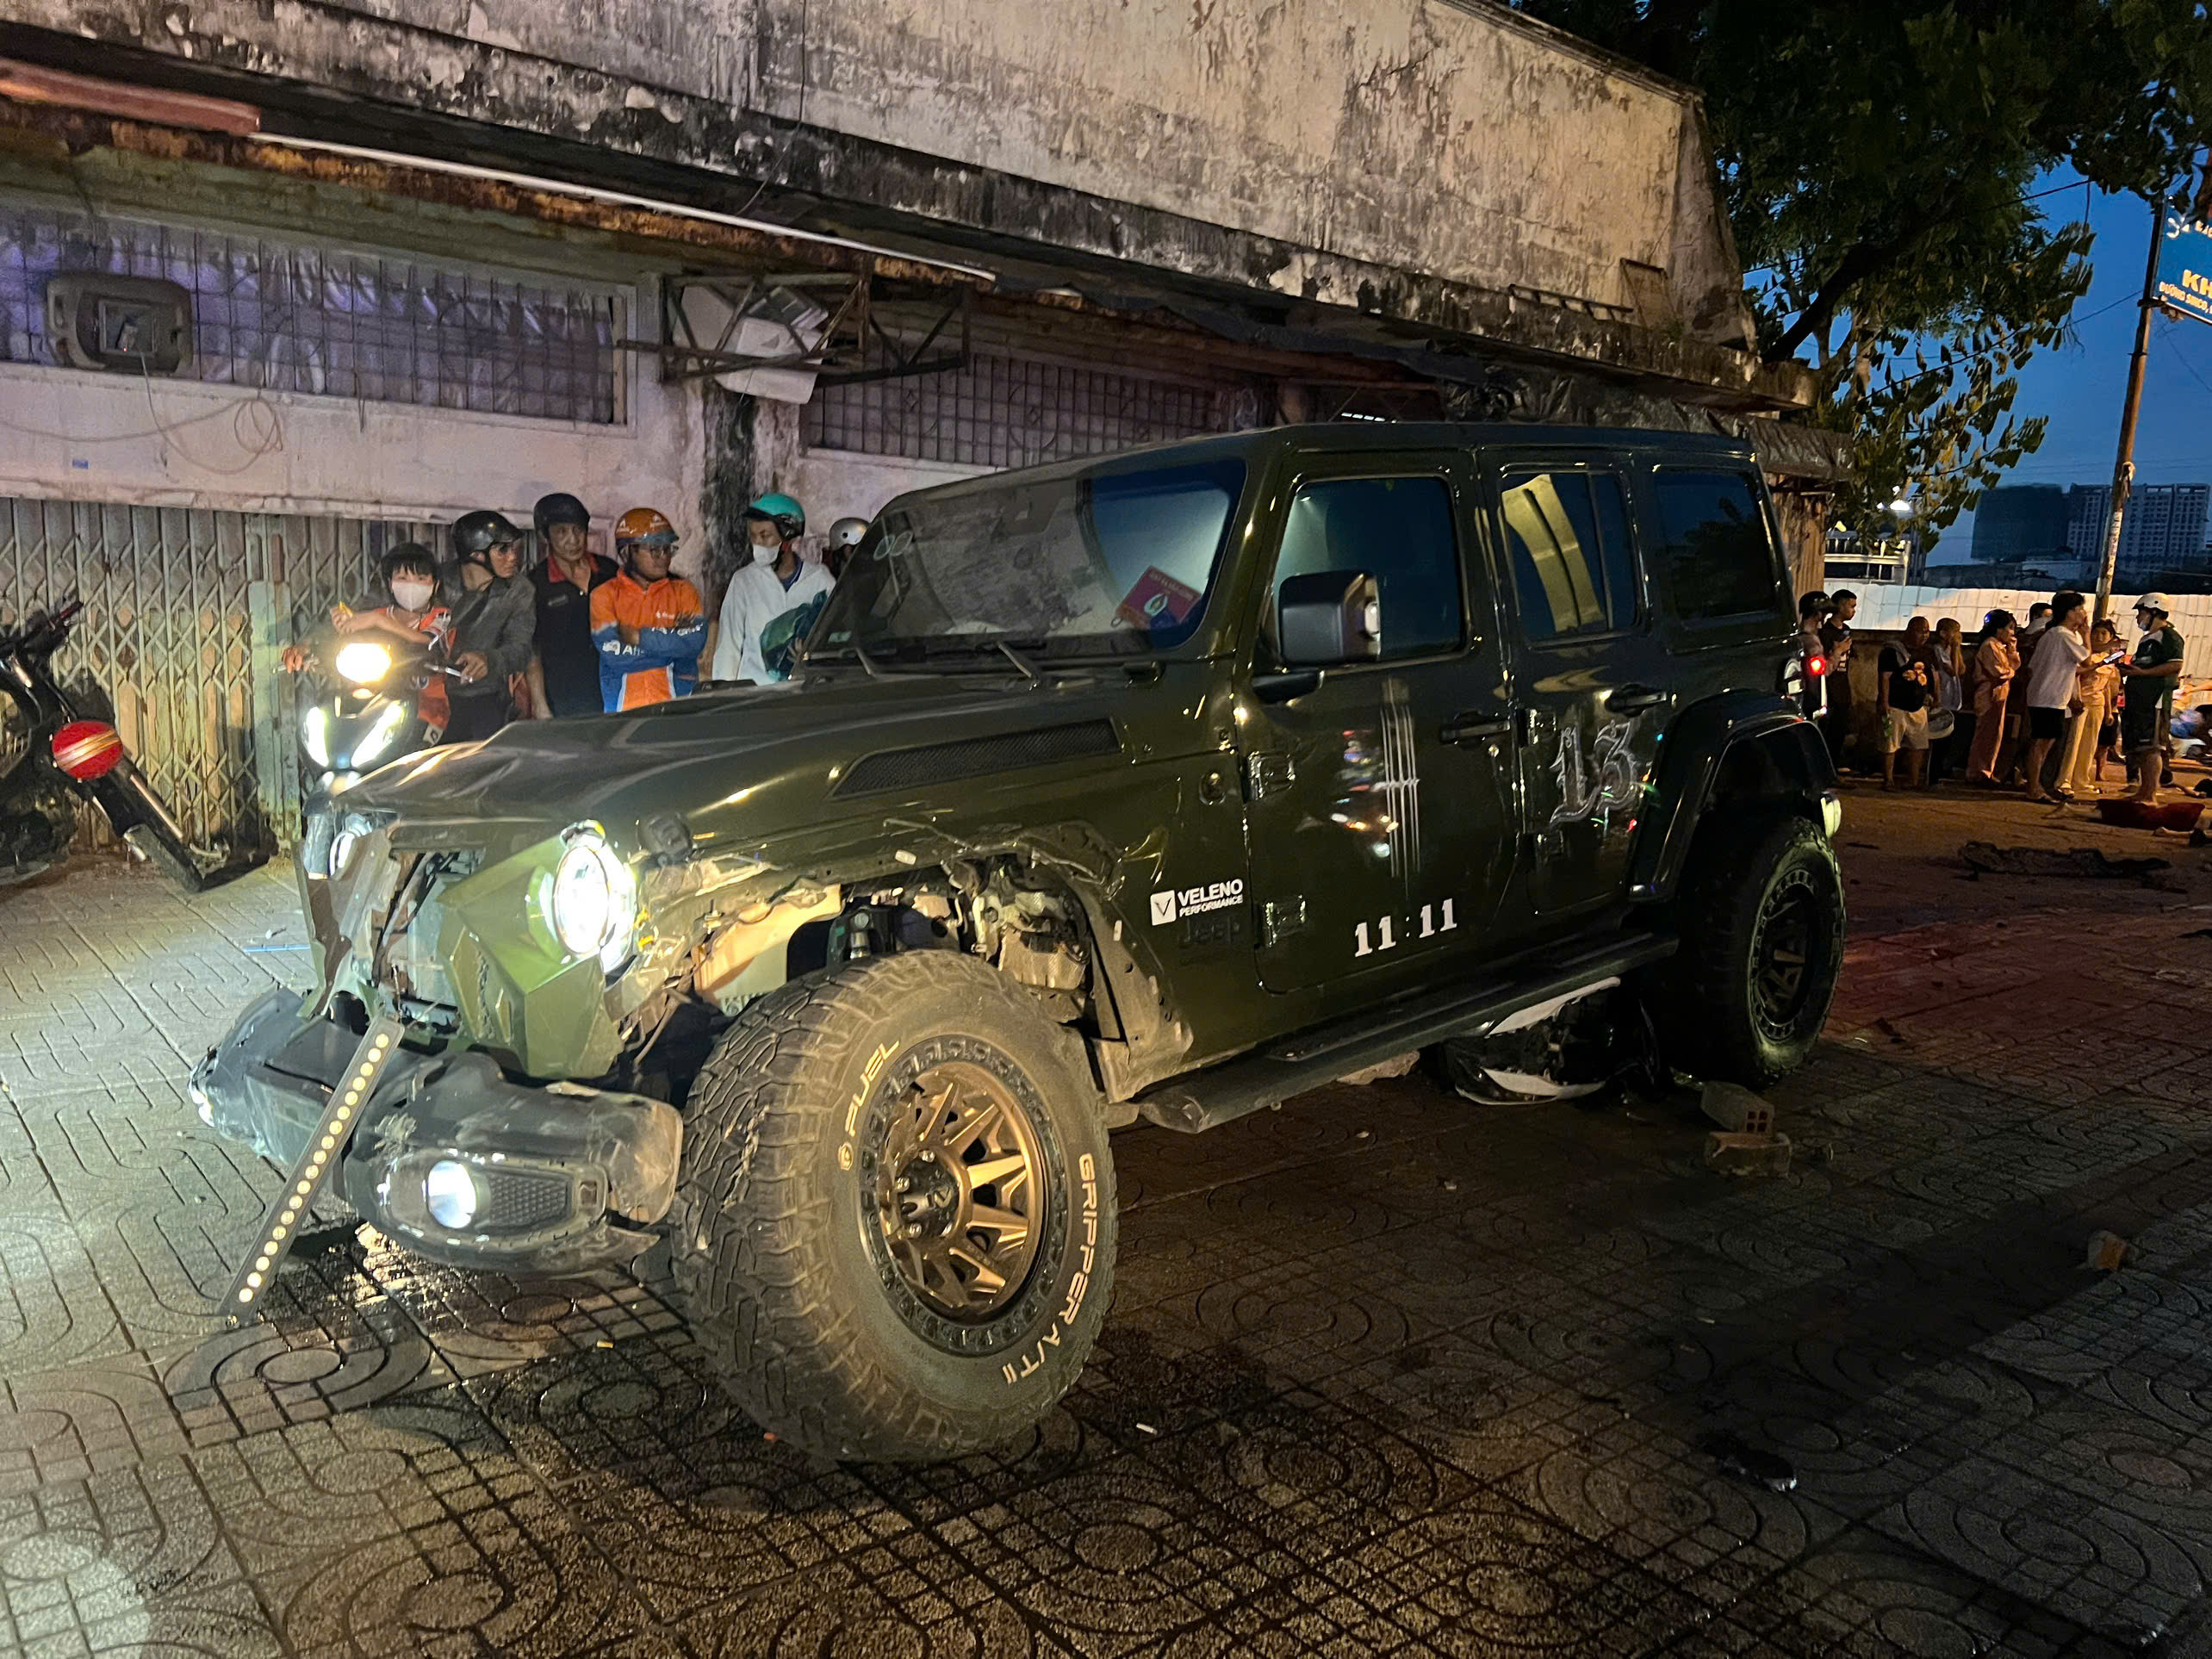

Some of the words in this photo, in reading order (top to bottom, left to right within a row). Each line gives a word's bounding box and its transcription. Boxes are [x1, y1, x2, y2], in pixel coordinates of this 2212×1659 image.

[1177, 878, 1243, 907] VELENO
[1178, 894, 1243, 917] PERFORMANCE
[845, 1040, 899, 1137] FUEL
[1059, 1153, 1098, 1326] GRIPPER
